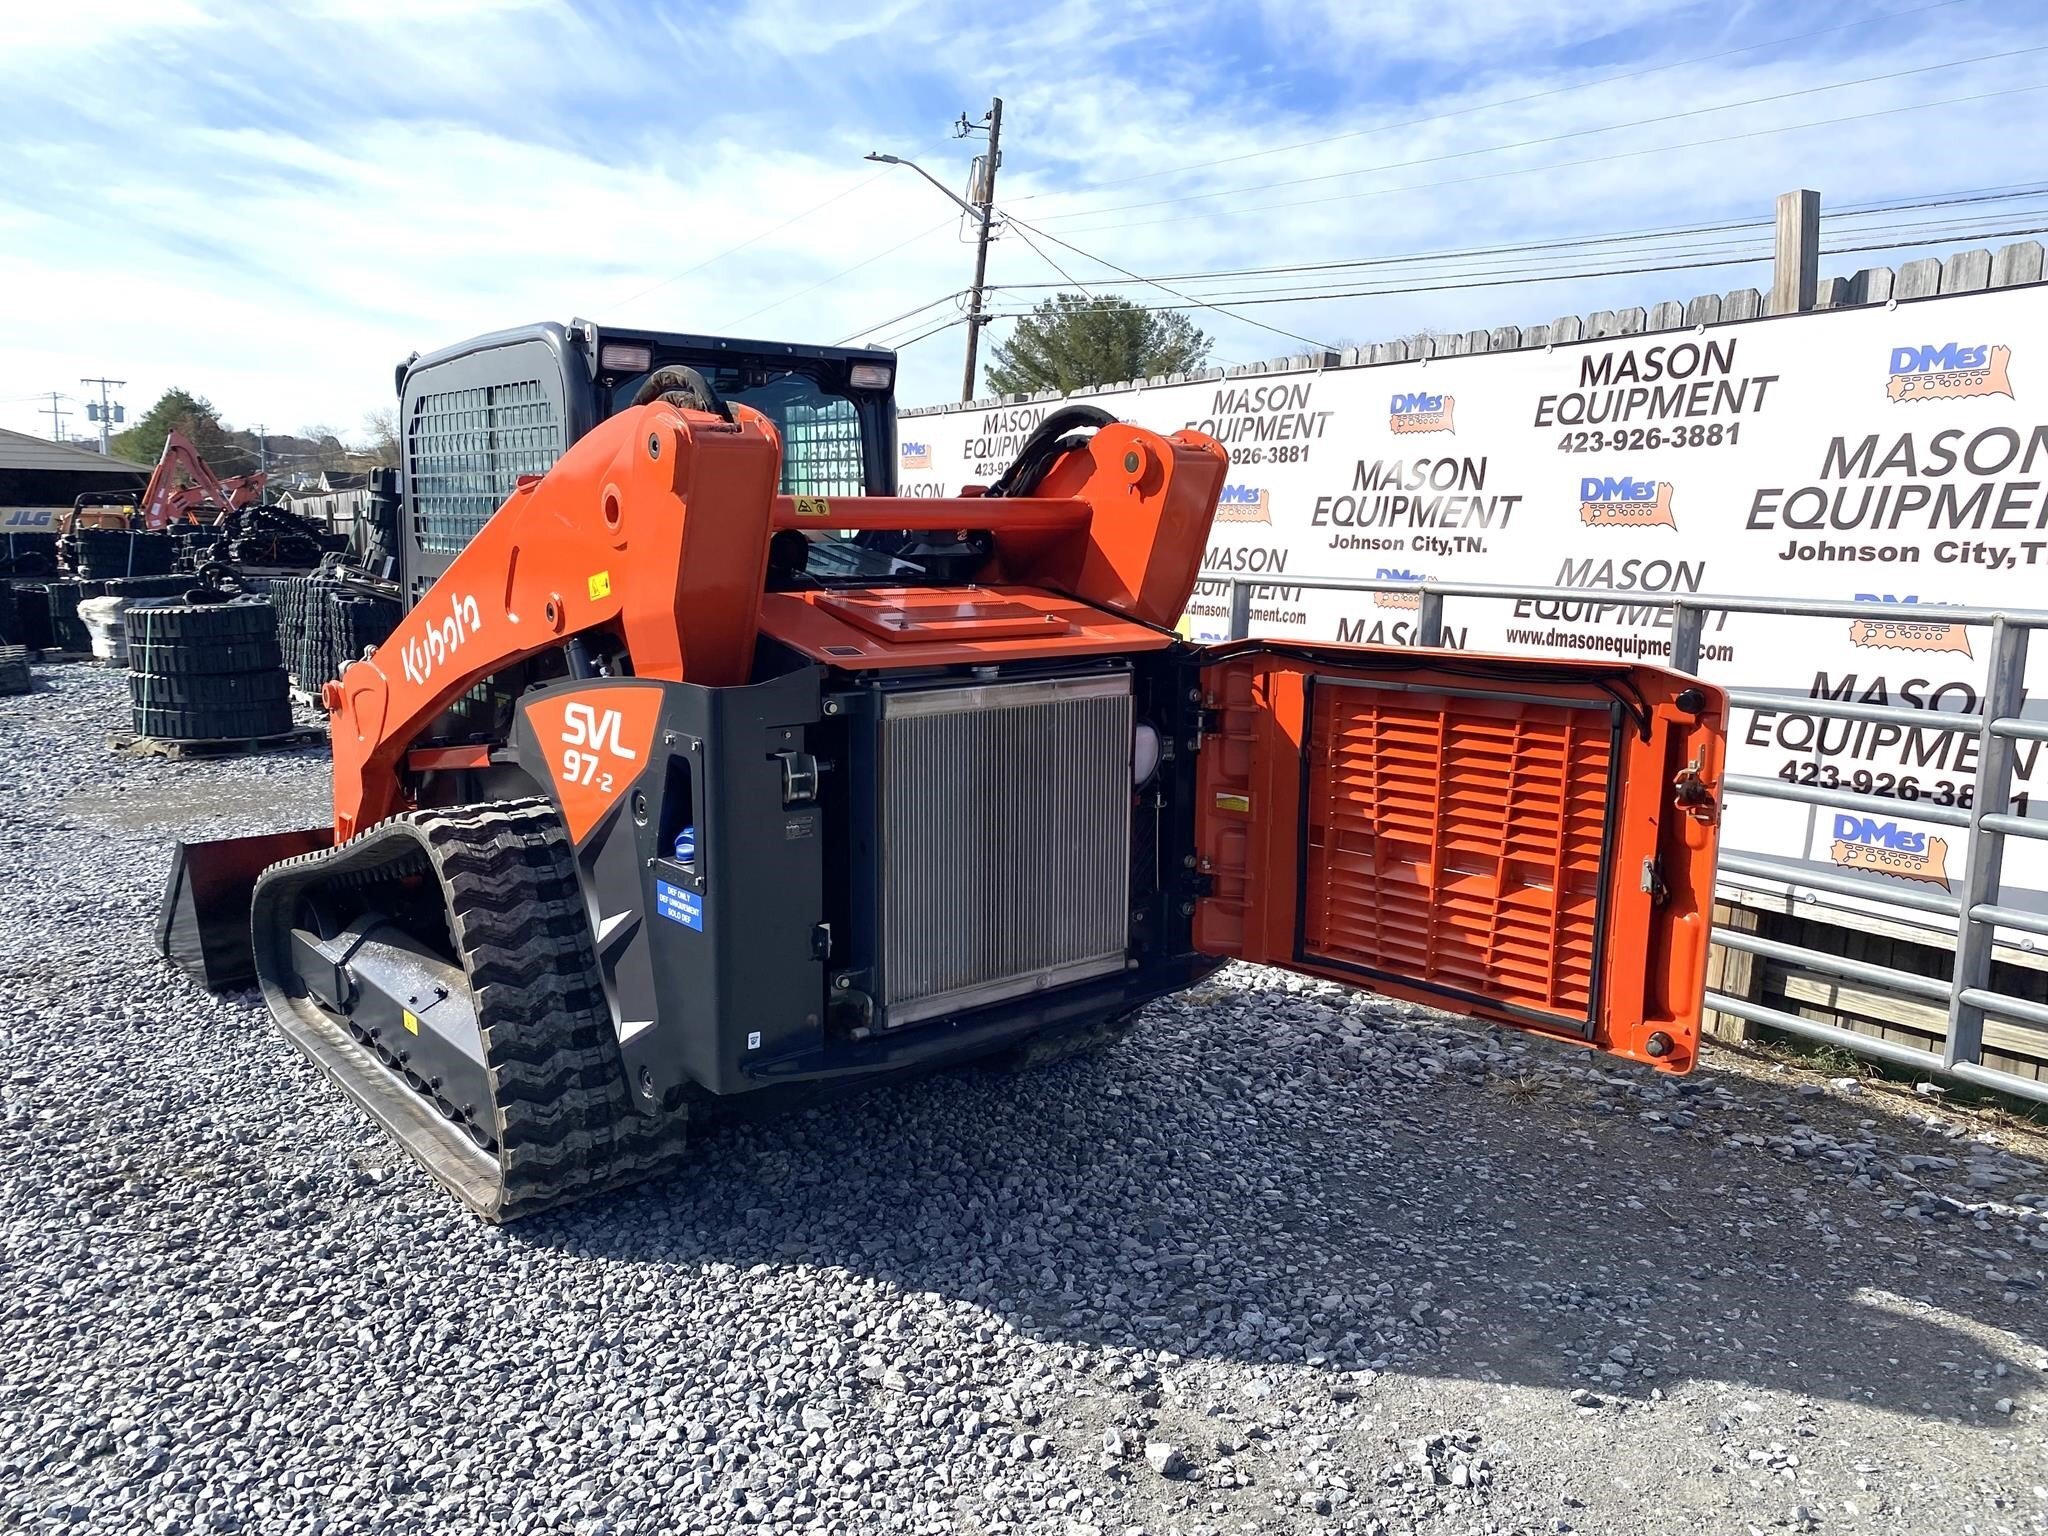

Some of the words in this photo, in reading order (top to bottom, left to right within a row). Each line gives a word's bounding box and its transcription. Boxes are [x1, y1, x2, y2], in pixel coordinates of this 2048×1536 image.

[1579, 338, 1737, 388] MASON
[1212, 382, 1312, 416] MASON
[1534, 375, 1779, 428] EQUIPMENT
[963, 433, 1032, 460] EQUIPM
[1557, 422, 1741, 453] 423-926-3881
[1352, 456, 1487, 491] MASON
[5, 511, 52, 526] JLG
[1311, 495, 1522, 530] EQUIPMENT
[1328, 534, 1404, 551] Johnson
[1411, 535, 1488, 556] City,TN.
[1778, 540, 1920, 563] Johnson
[1555, 557, 1706, 592] MASON
[401, 592, 481, 686] Kubota
[561, 702, 636, 760] SVL
[562, 750, 614, 793] 97-2
[1778, 760, 2029, 818] 423-926-381
